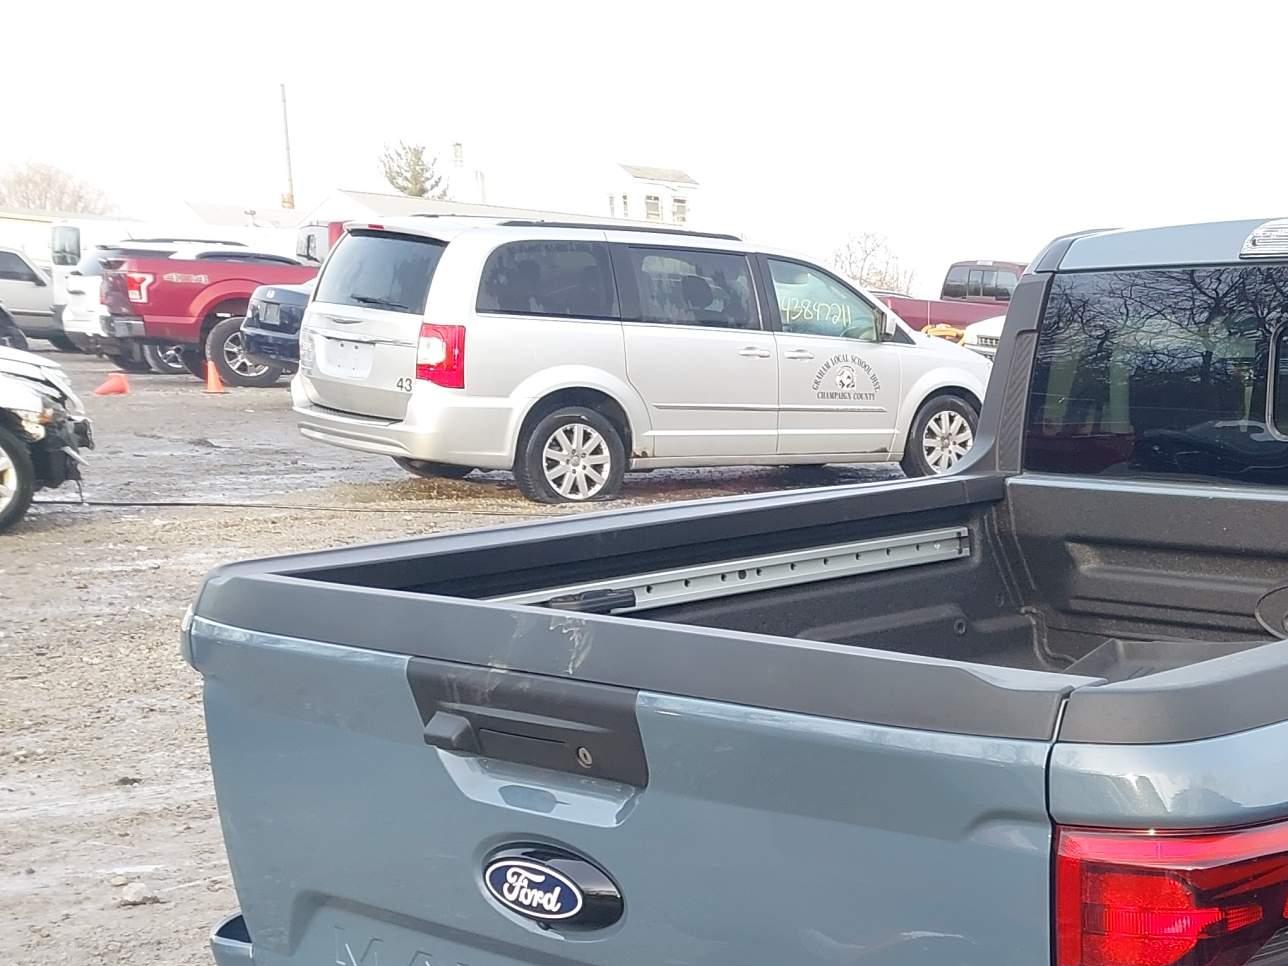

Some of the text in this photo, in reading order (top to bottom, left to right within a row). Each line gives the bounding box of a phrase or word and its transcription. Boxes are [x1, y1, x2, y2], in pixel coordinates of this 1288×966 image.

[396, 377, 413, 393] 43
[812, 361, 832, 392] GRAHAM
[830, 353, 850, 367] LOCAL
[850, 354, 872, 376] SCHOOL
[816, 391, 876, 401] CHAMPAIGN COUNTY
[503, 866, 562, 913] Ford
